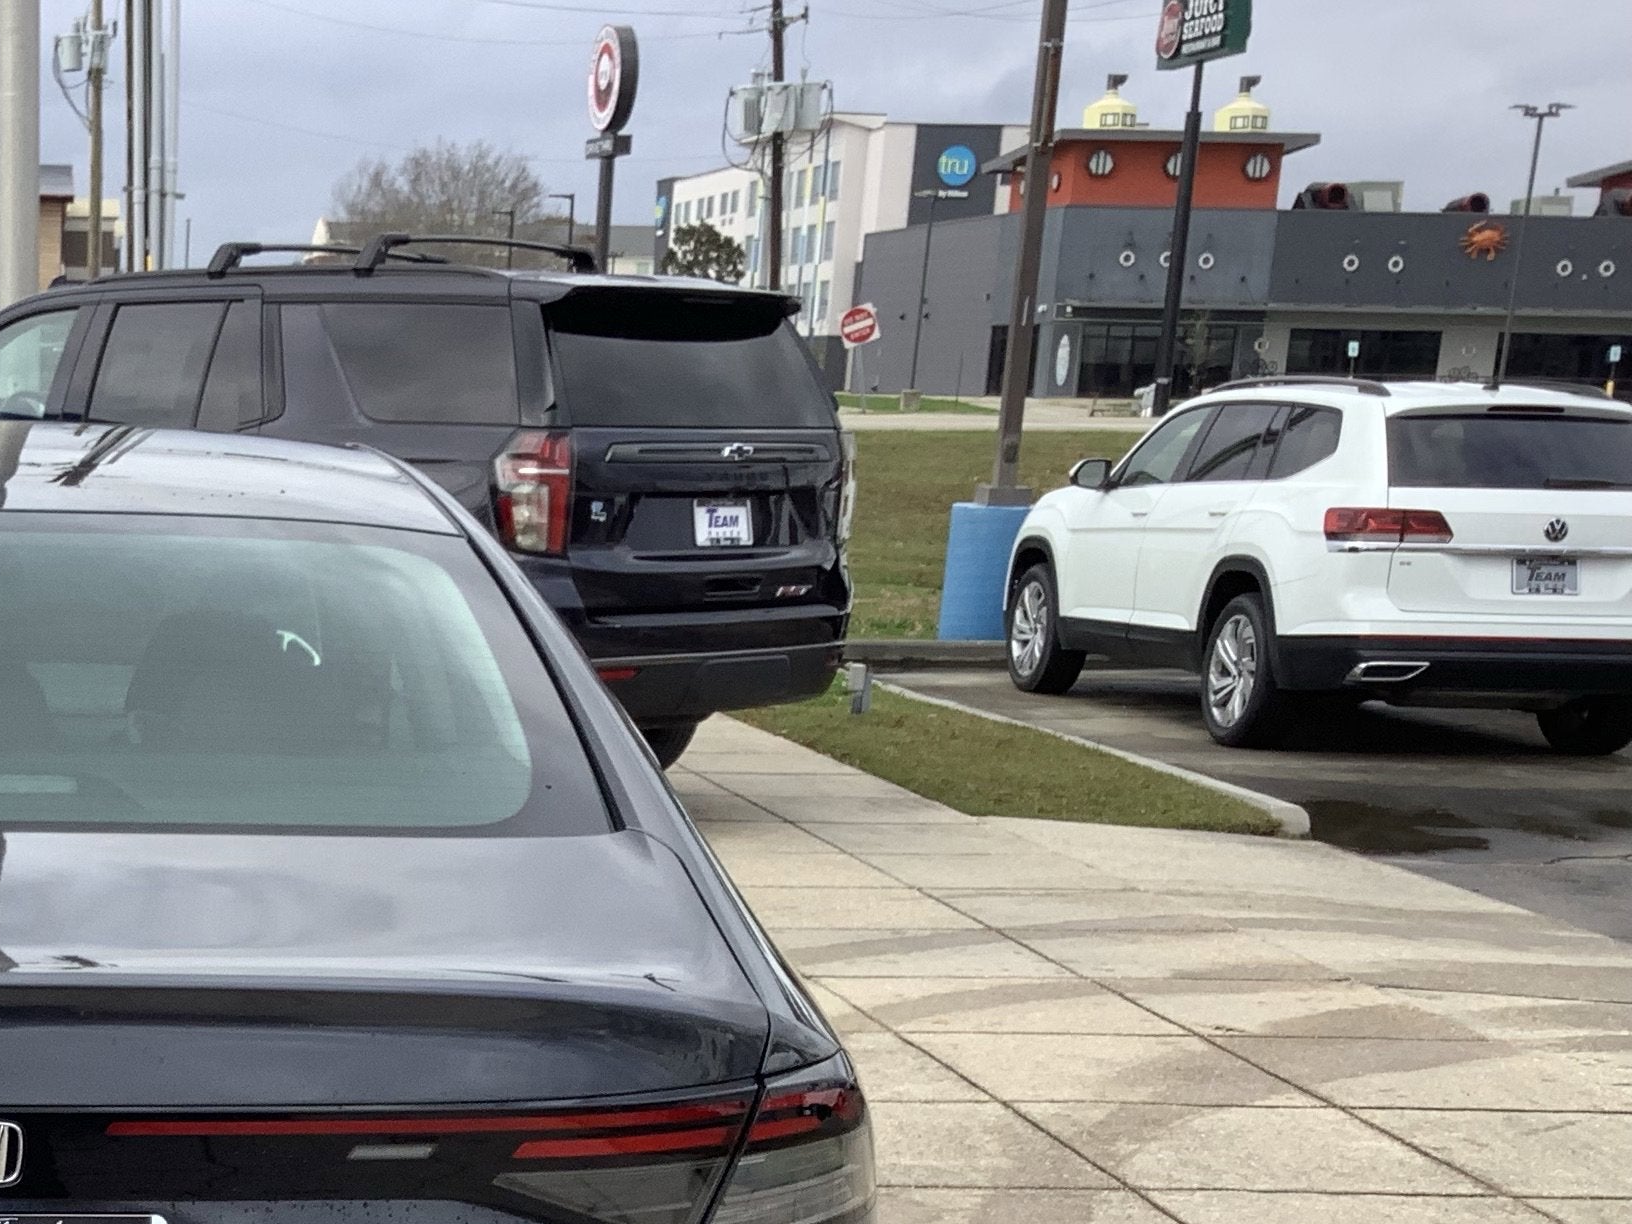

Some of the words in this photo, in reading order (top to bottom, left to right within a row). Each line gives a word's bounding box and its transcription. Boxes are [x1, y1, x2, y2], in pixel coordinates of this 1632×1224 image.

[1181, 12, 1224, 40] SEAFOOD
[939, 155, 969, 175] tru
[707, 507, 739, 528] TEAM
[1527, 564, 1566, 582] TEAM
